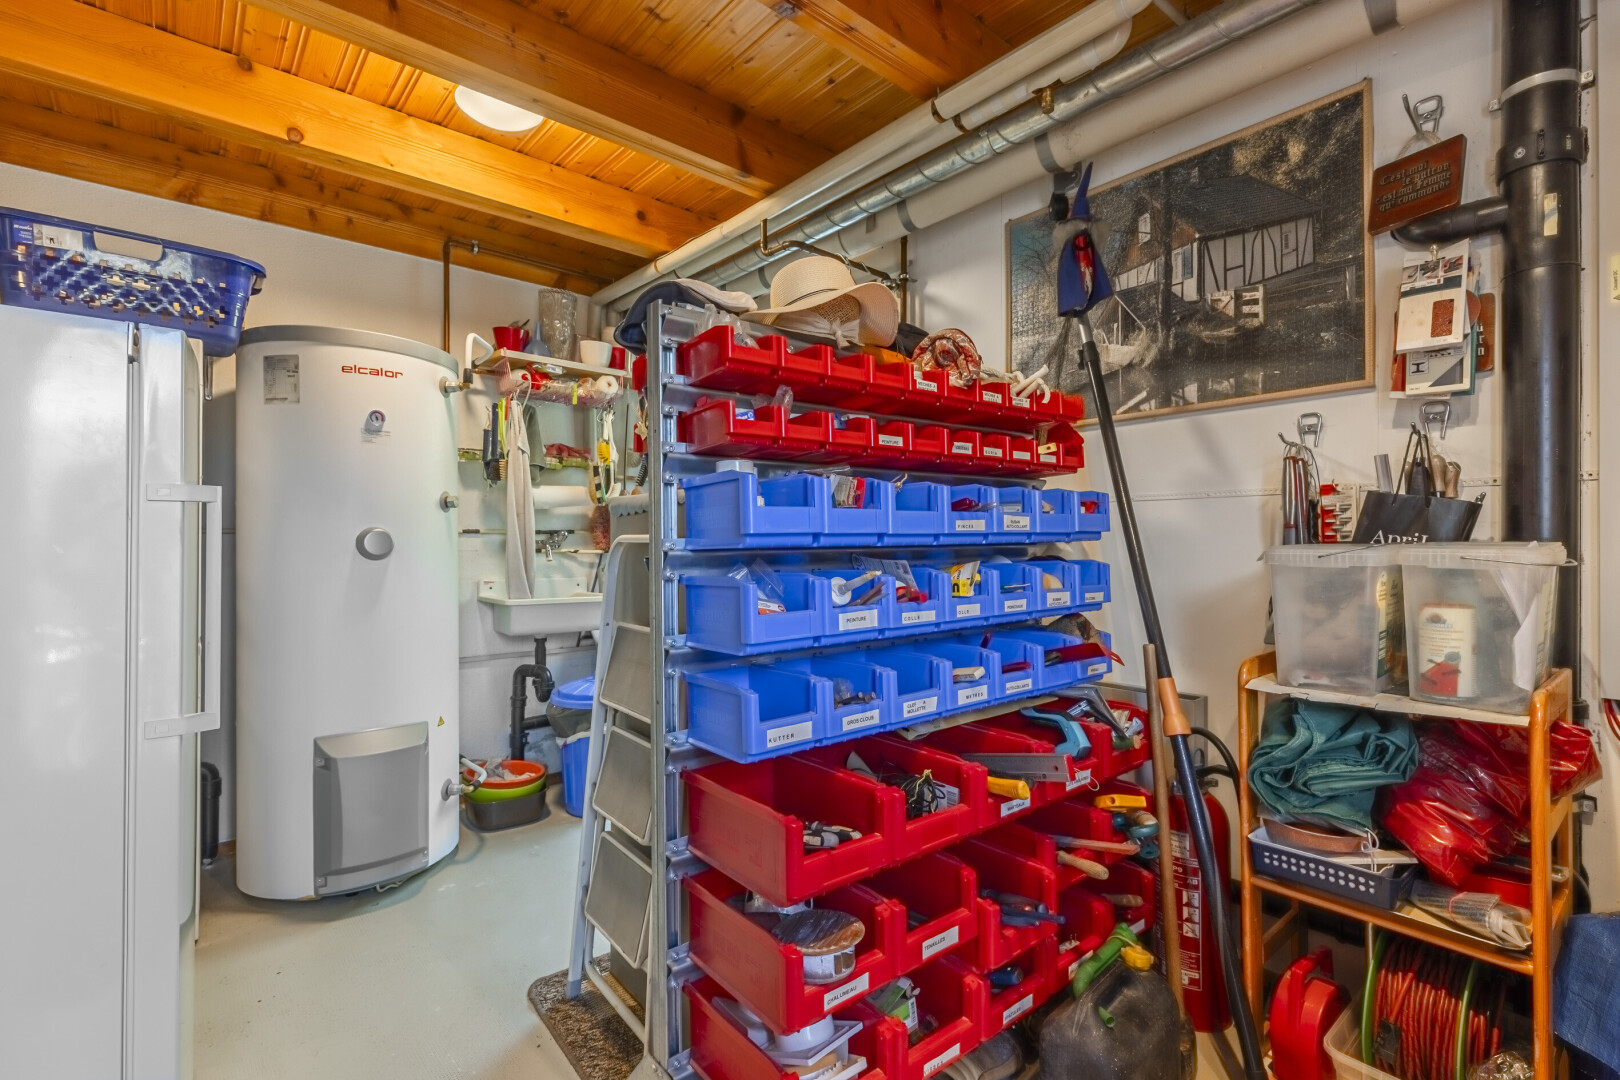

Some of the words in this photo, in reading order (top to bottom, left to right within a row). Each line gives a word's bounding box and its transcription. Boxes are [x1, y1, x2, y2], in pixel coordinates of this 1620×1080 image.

[341, 364, 404, 379] elcalor
[847, 718, 859, 726] GROS
[768, 733, 795, 744] KUTTER
[924, 936, 946, 951] TENAILLES
[826, 985, 857, 1006] CHALUMEAU
